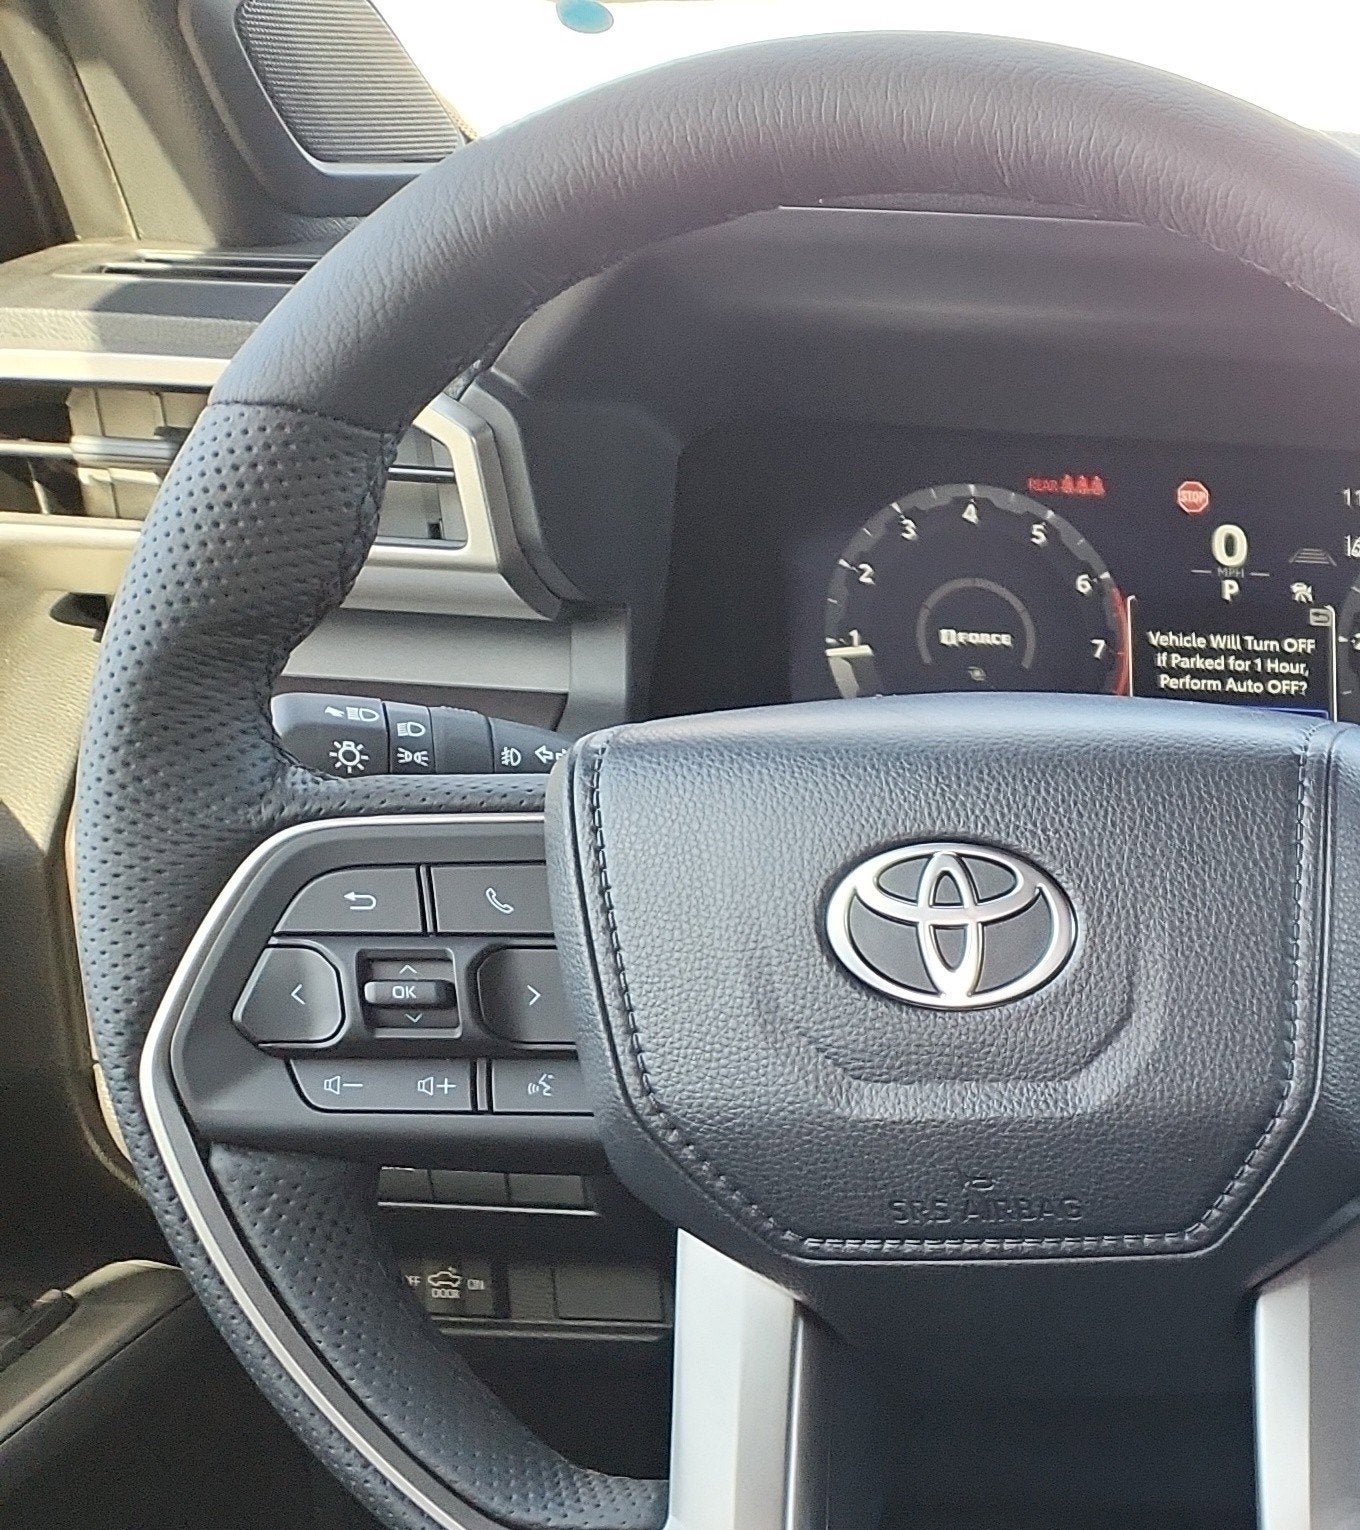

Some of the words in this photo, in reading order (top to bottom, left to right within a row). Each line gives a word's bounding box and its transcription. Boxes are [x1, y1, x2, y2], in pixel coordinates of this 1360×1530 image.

[901, 518, 918, 540] 3
[1031, 524, 1047, 546] 5
[1212, 524, 1248, 567] 0
[858, 564, 874, 584] 2
[1217, 568, 1245, 578] MPH
[1076, 575, 1092, 595] 6
[1221, 580, 1240, 602] P
[849, 629, 861, 647] 1
[1091, 639, 1105, 658] 7
[1148, 631, 1207, 648] Vehicle
[1210, 633, 1241, 650] Will
[1244, 636, 1280, 652] Turn
[1283, 638, 1315, 654] OFF
[1156, 653, 1167, 668] If
[1171, 654, 1225, 670] Parked
[1228, 655, 1251, 671] for
[1254, 657, 1261, 673] 1
[1266, 659, 1309, 676] Hour,
[1160, 674, 1221, 691] Perform
[1225, 678, 1264, 694] Auto
[1268, 679, 1308, 696] OFF?
[391, 986, 417, 999] OK
